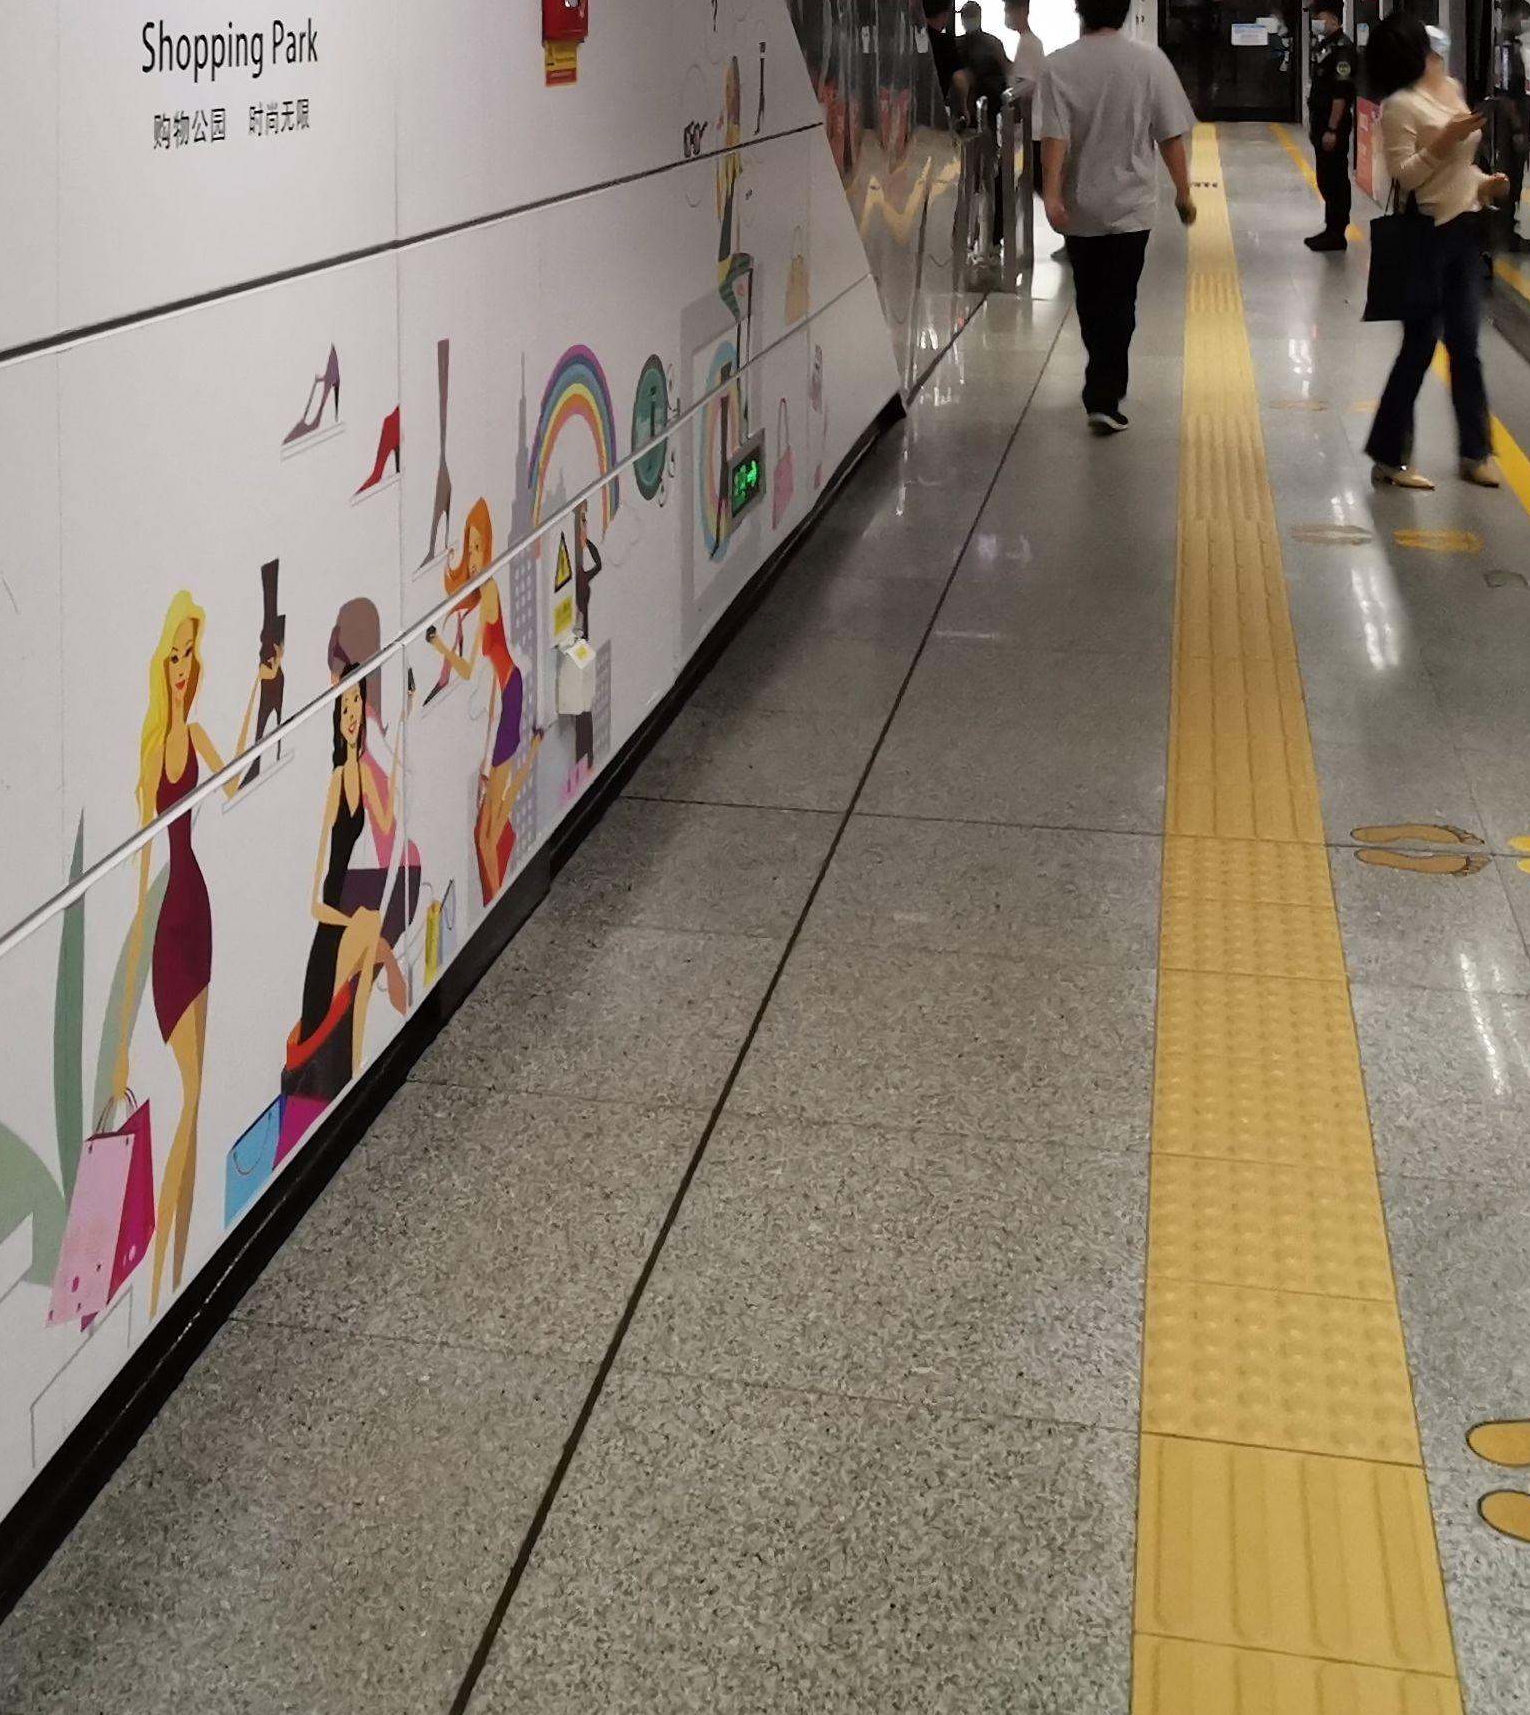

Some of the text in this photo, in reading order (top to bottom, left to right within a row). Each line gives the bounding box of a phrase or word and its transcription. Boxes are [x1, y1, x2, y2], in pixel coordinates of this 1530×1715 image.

[141, 17, 318, 83] Shopping Park
[153, 98, 310, 149] 购物公园 时尚无限
